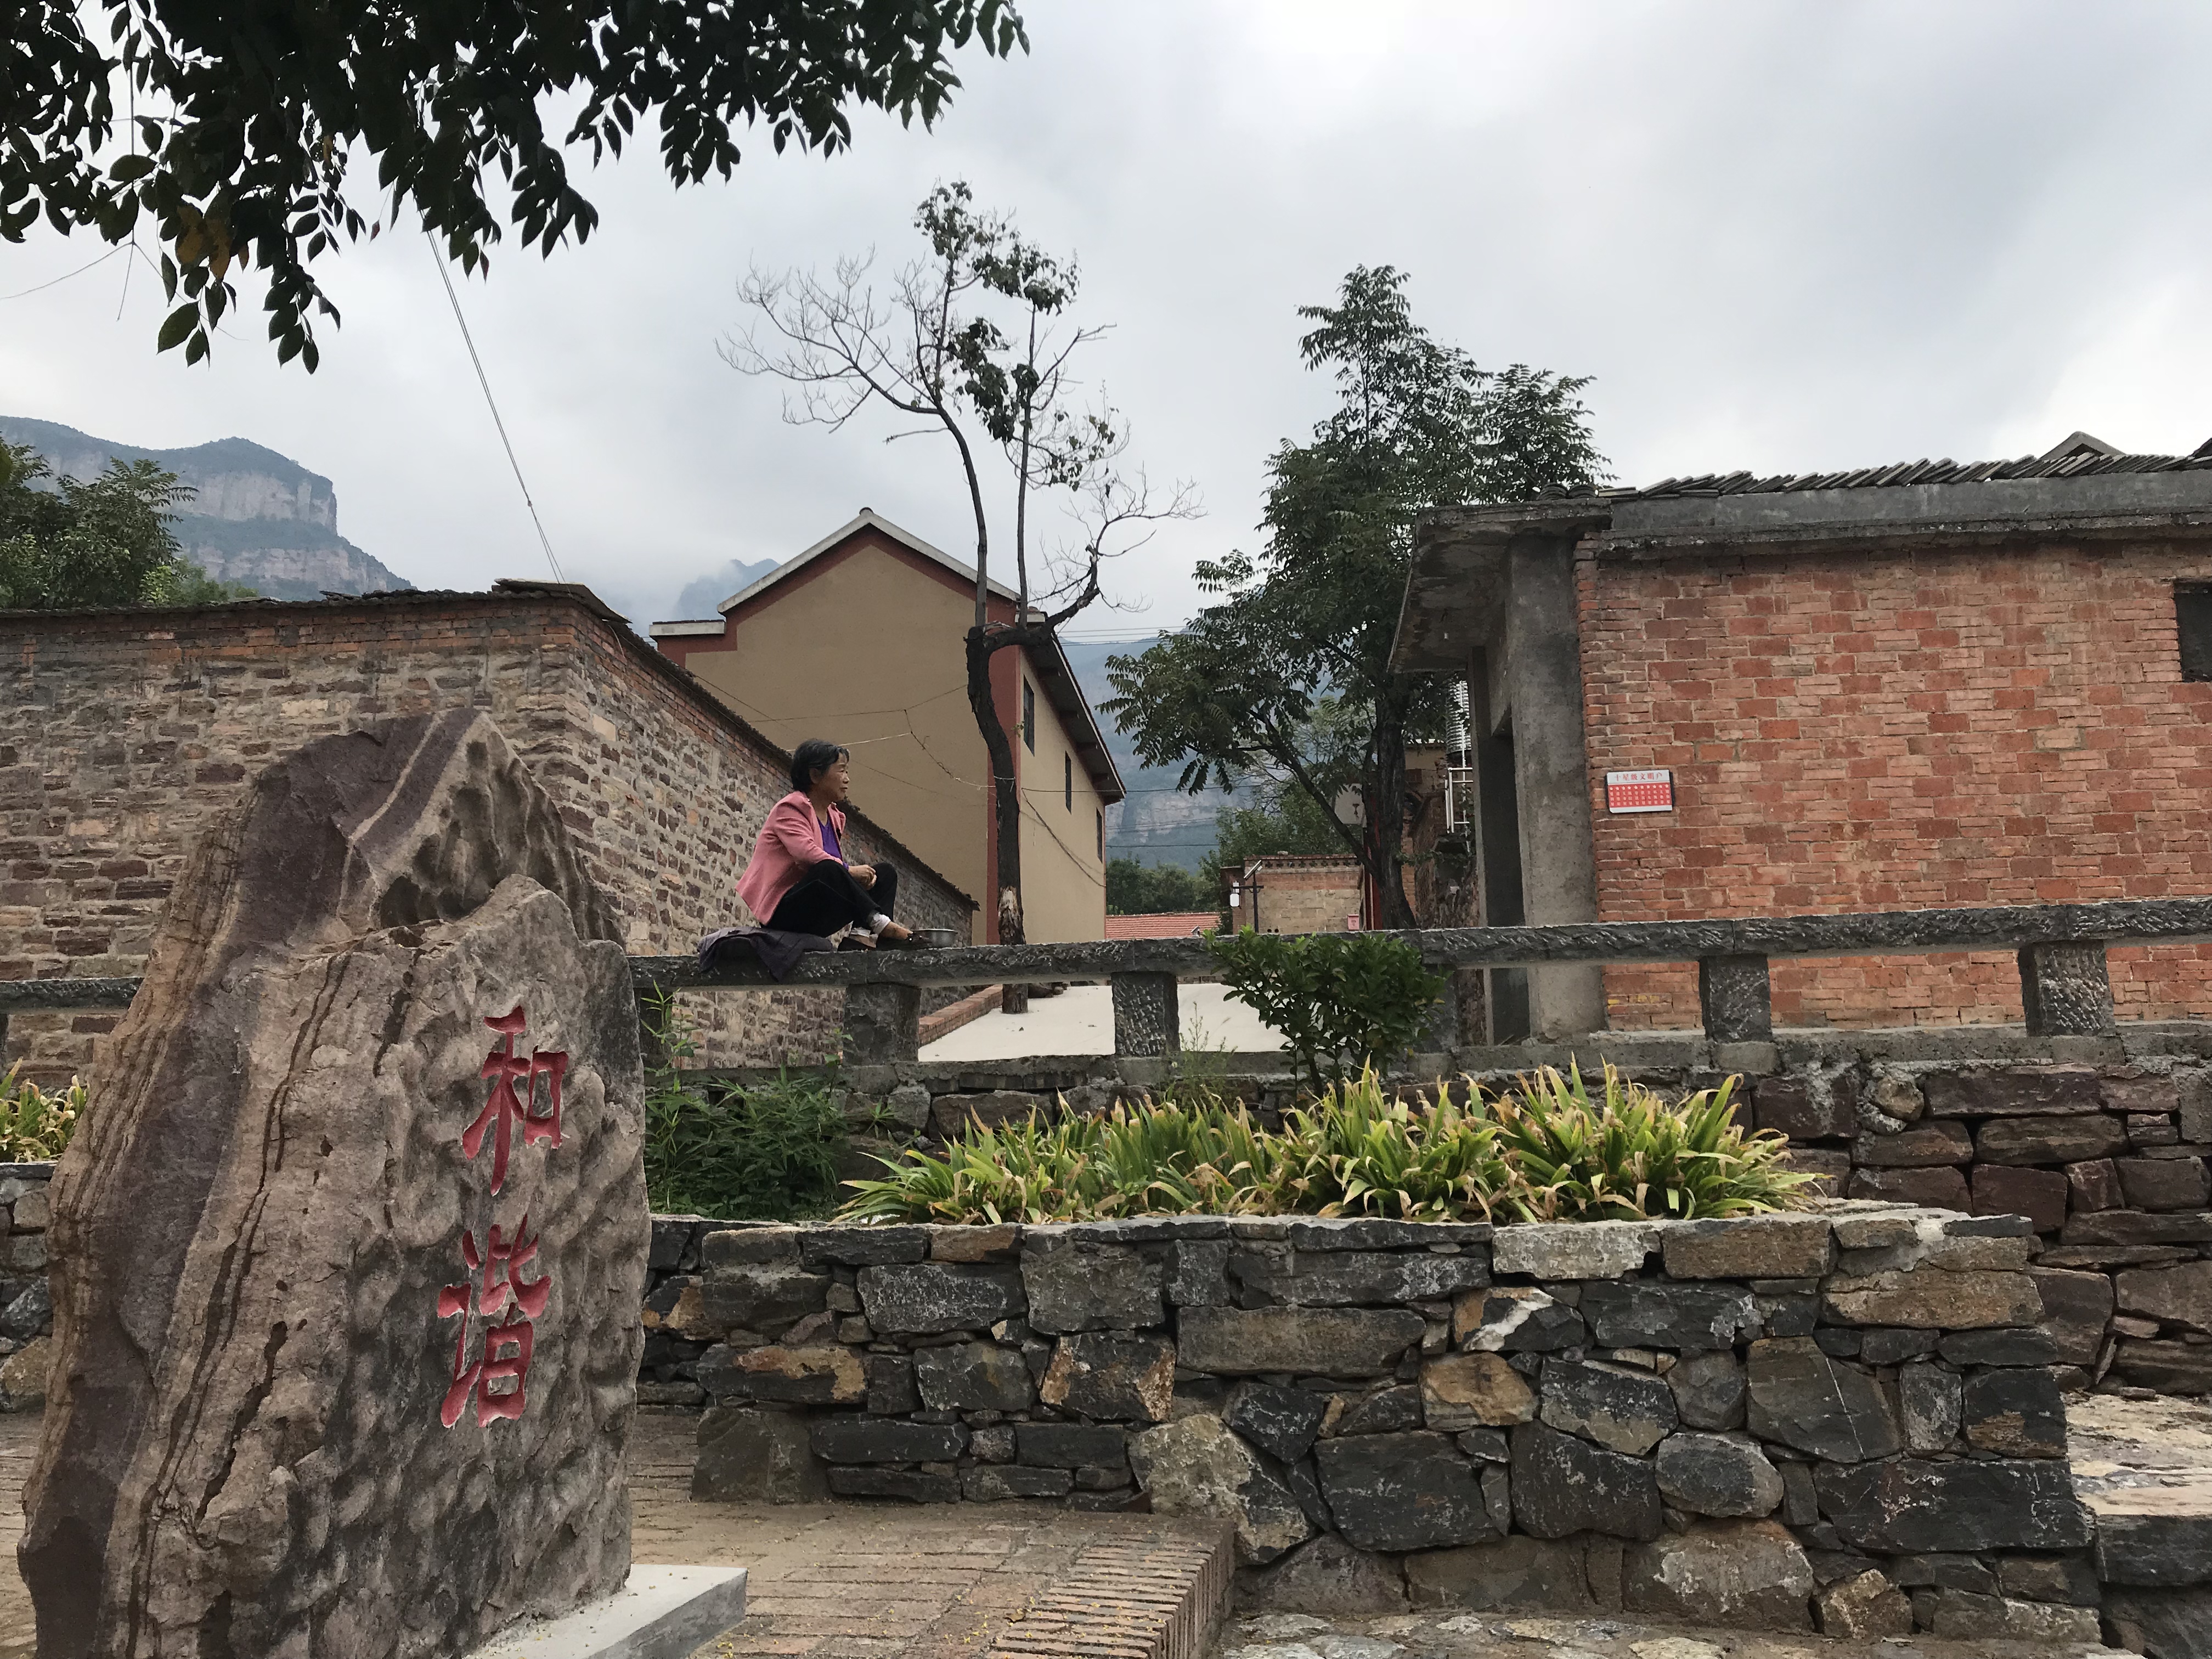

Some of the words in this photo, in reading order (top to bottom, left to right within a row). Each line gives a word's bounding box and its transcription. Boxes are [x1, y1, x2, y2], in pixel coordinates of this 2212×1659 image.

[1615, 772, 1662, 782] 十星级文明户
[438, 1006, 569, 1429] 和谐
